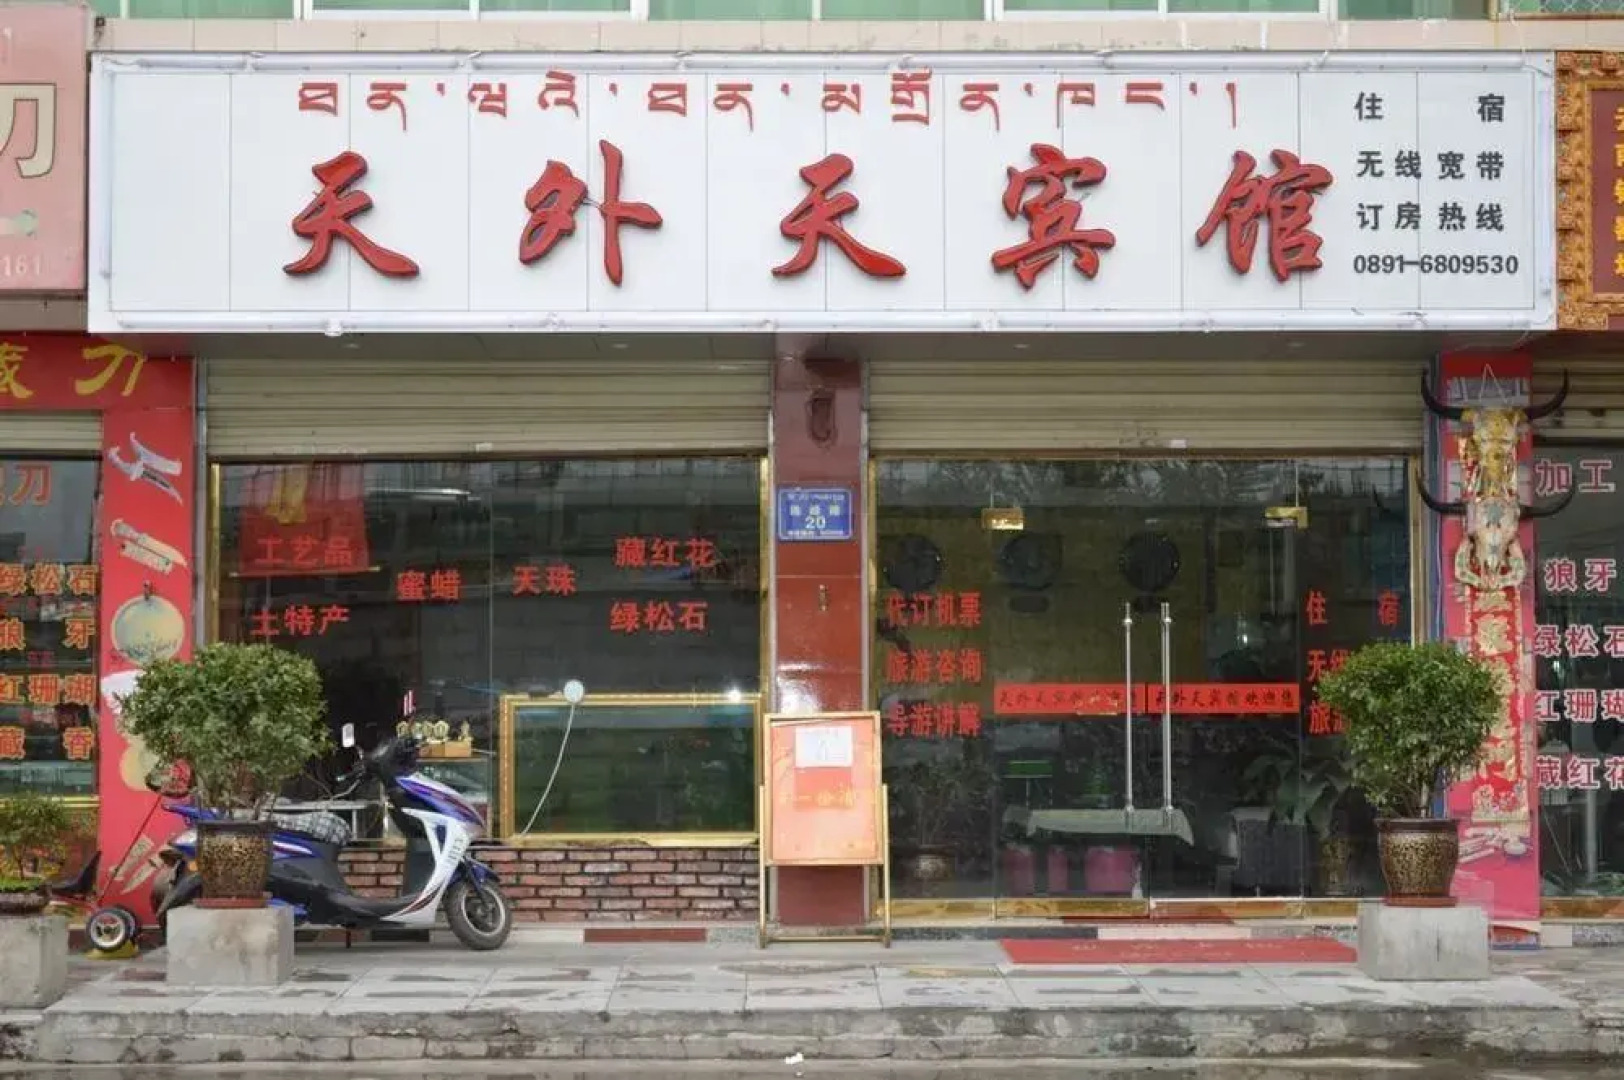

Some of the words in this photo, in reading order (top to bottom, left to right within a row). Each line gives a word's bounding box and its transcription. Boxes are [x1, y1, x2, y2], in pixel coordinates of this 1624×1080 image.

[1354, 91, 1505, 122] 住宿
[1356, 150, 1504, 180] 无线宽带
[284, 140, 1334, 290] 天外天宾馆
[1356, 201, 1504, 231] 订房热线
[1353, 254, 1519, 274] 0891-6809530
[1535, 457, 1616, 496] 加工
[805, 515, 825, 529] 20
[254, 534, 352, 566] 工艺品
[614, 535, 716, 568] 藏红花
[396, 568, 461, 602] 蜜蜡
[513, 564, 577, 597] 天珠
[1544, 556, 1617, 593] 狼牙
[250, 604, 349, 636] 土特产
[610, 601, 709, 634] 绿松石
[887, 648, 983, 683] 旅游咨询
